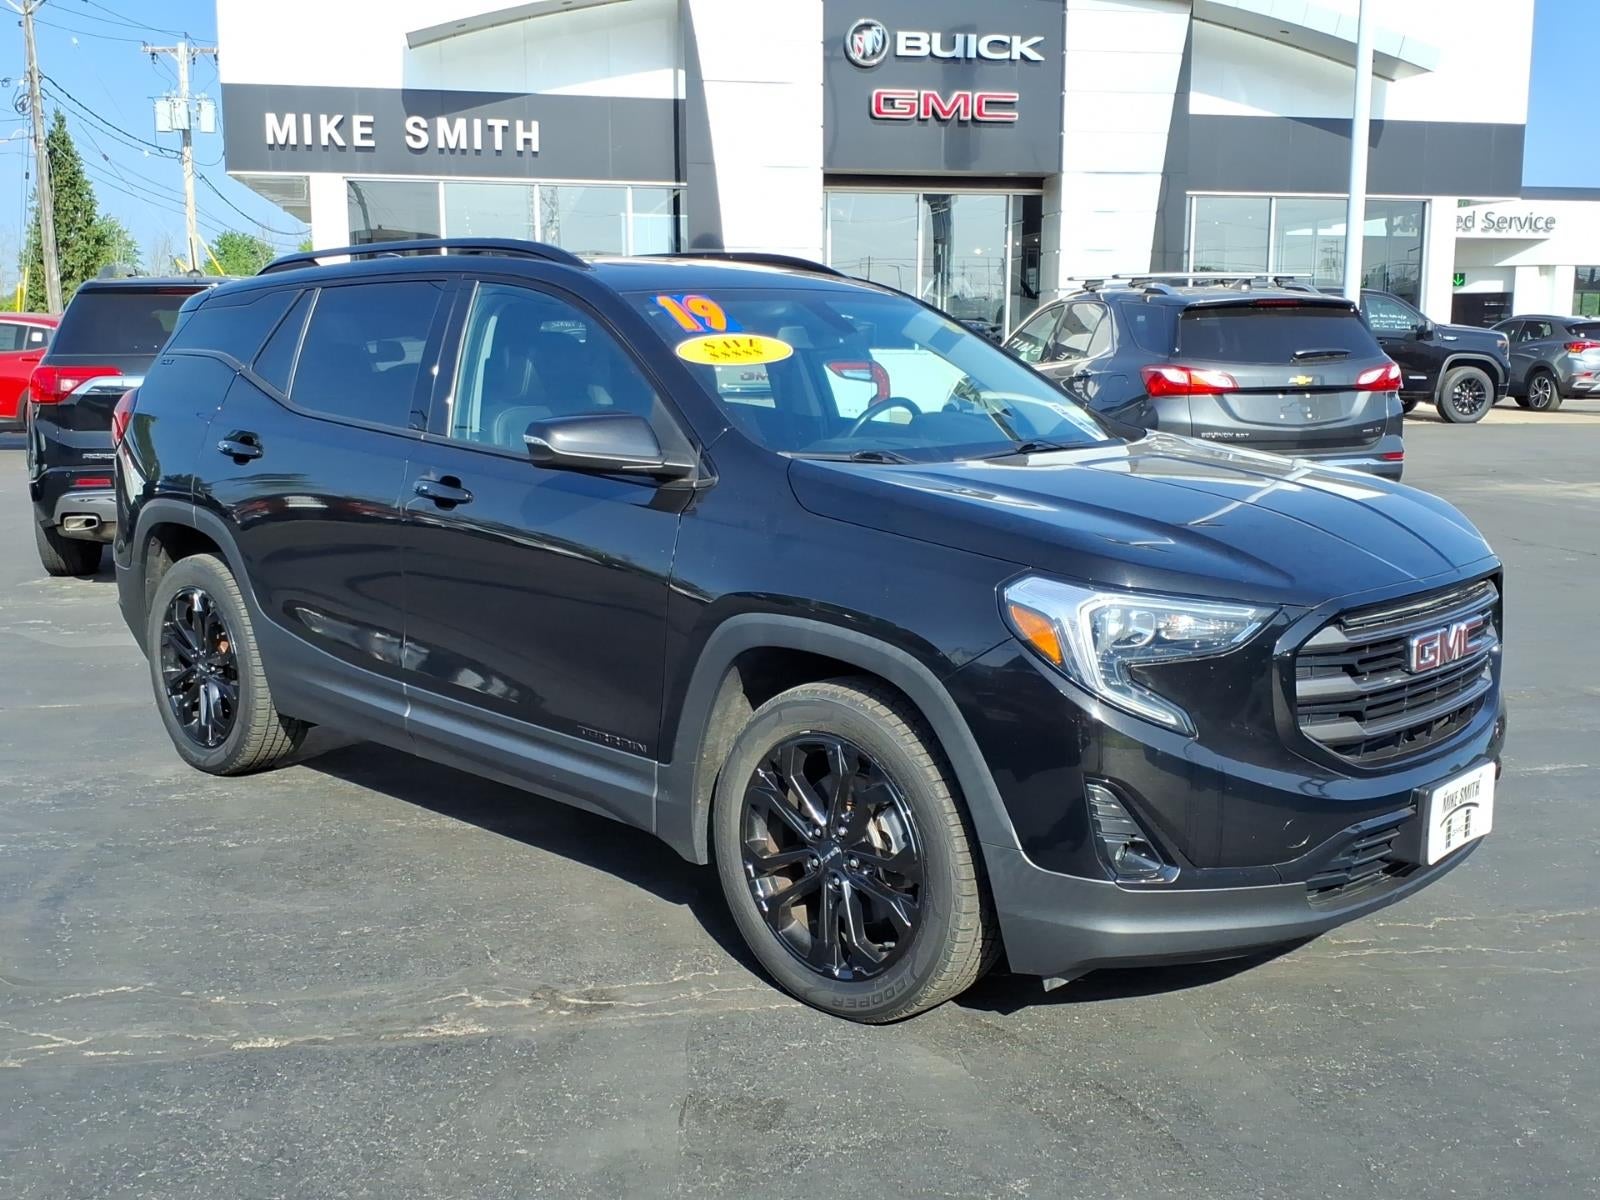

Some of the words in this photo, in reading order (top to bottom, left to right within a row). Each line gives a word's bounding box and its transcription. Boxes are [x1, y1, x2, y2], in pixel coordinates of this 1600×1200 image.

[895, 30, 1045, 61] BUICK
[871, 88, 1019, 122] GMC
[265, 112, 376, 148] MIKE
[405, 115, 541, 153] SMITH
[1484, 211, 1556, 230] Service
[656, 295, 727, 333] 19
[1411, 615, 1484, 672] GMC
[1443, 791, 1458, 813] MIKE
[1460, 780, 1480, 803] SMITH
